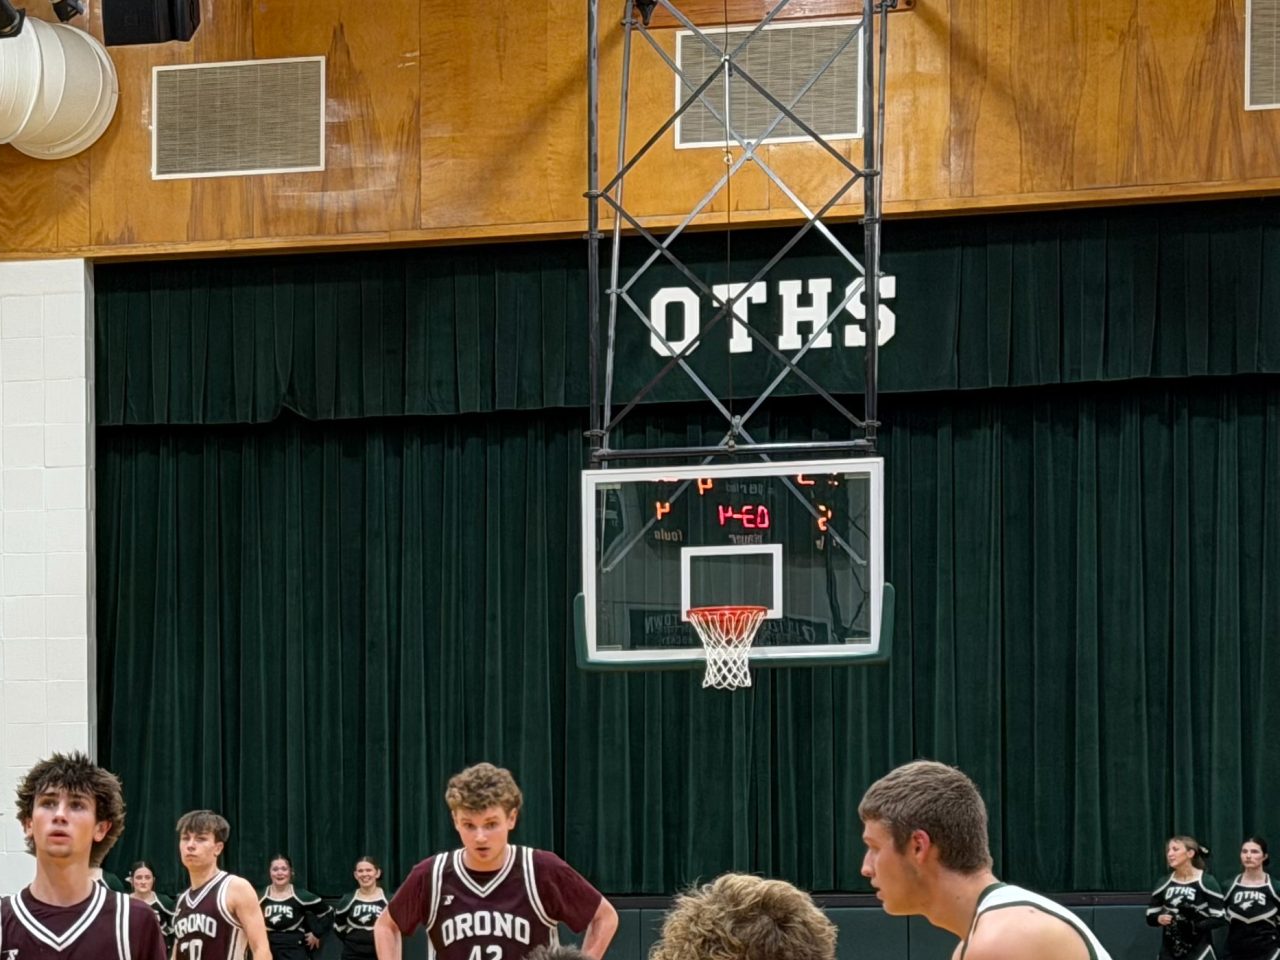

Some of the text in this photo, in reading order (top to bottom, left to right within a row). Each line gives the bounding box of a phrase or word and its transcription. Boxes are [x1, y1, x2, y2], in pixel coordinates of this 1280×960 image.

[649, 275, 897, 357] OTHS
[1165, 886, 1197, 901] OTHS
[1234, 890, 1267, 906] OTHS
[264, 904, 294, 919] OTHS
[174, 912, 217, 939] ORONO
[441, 910, 530, 947] ORONO
